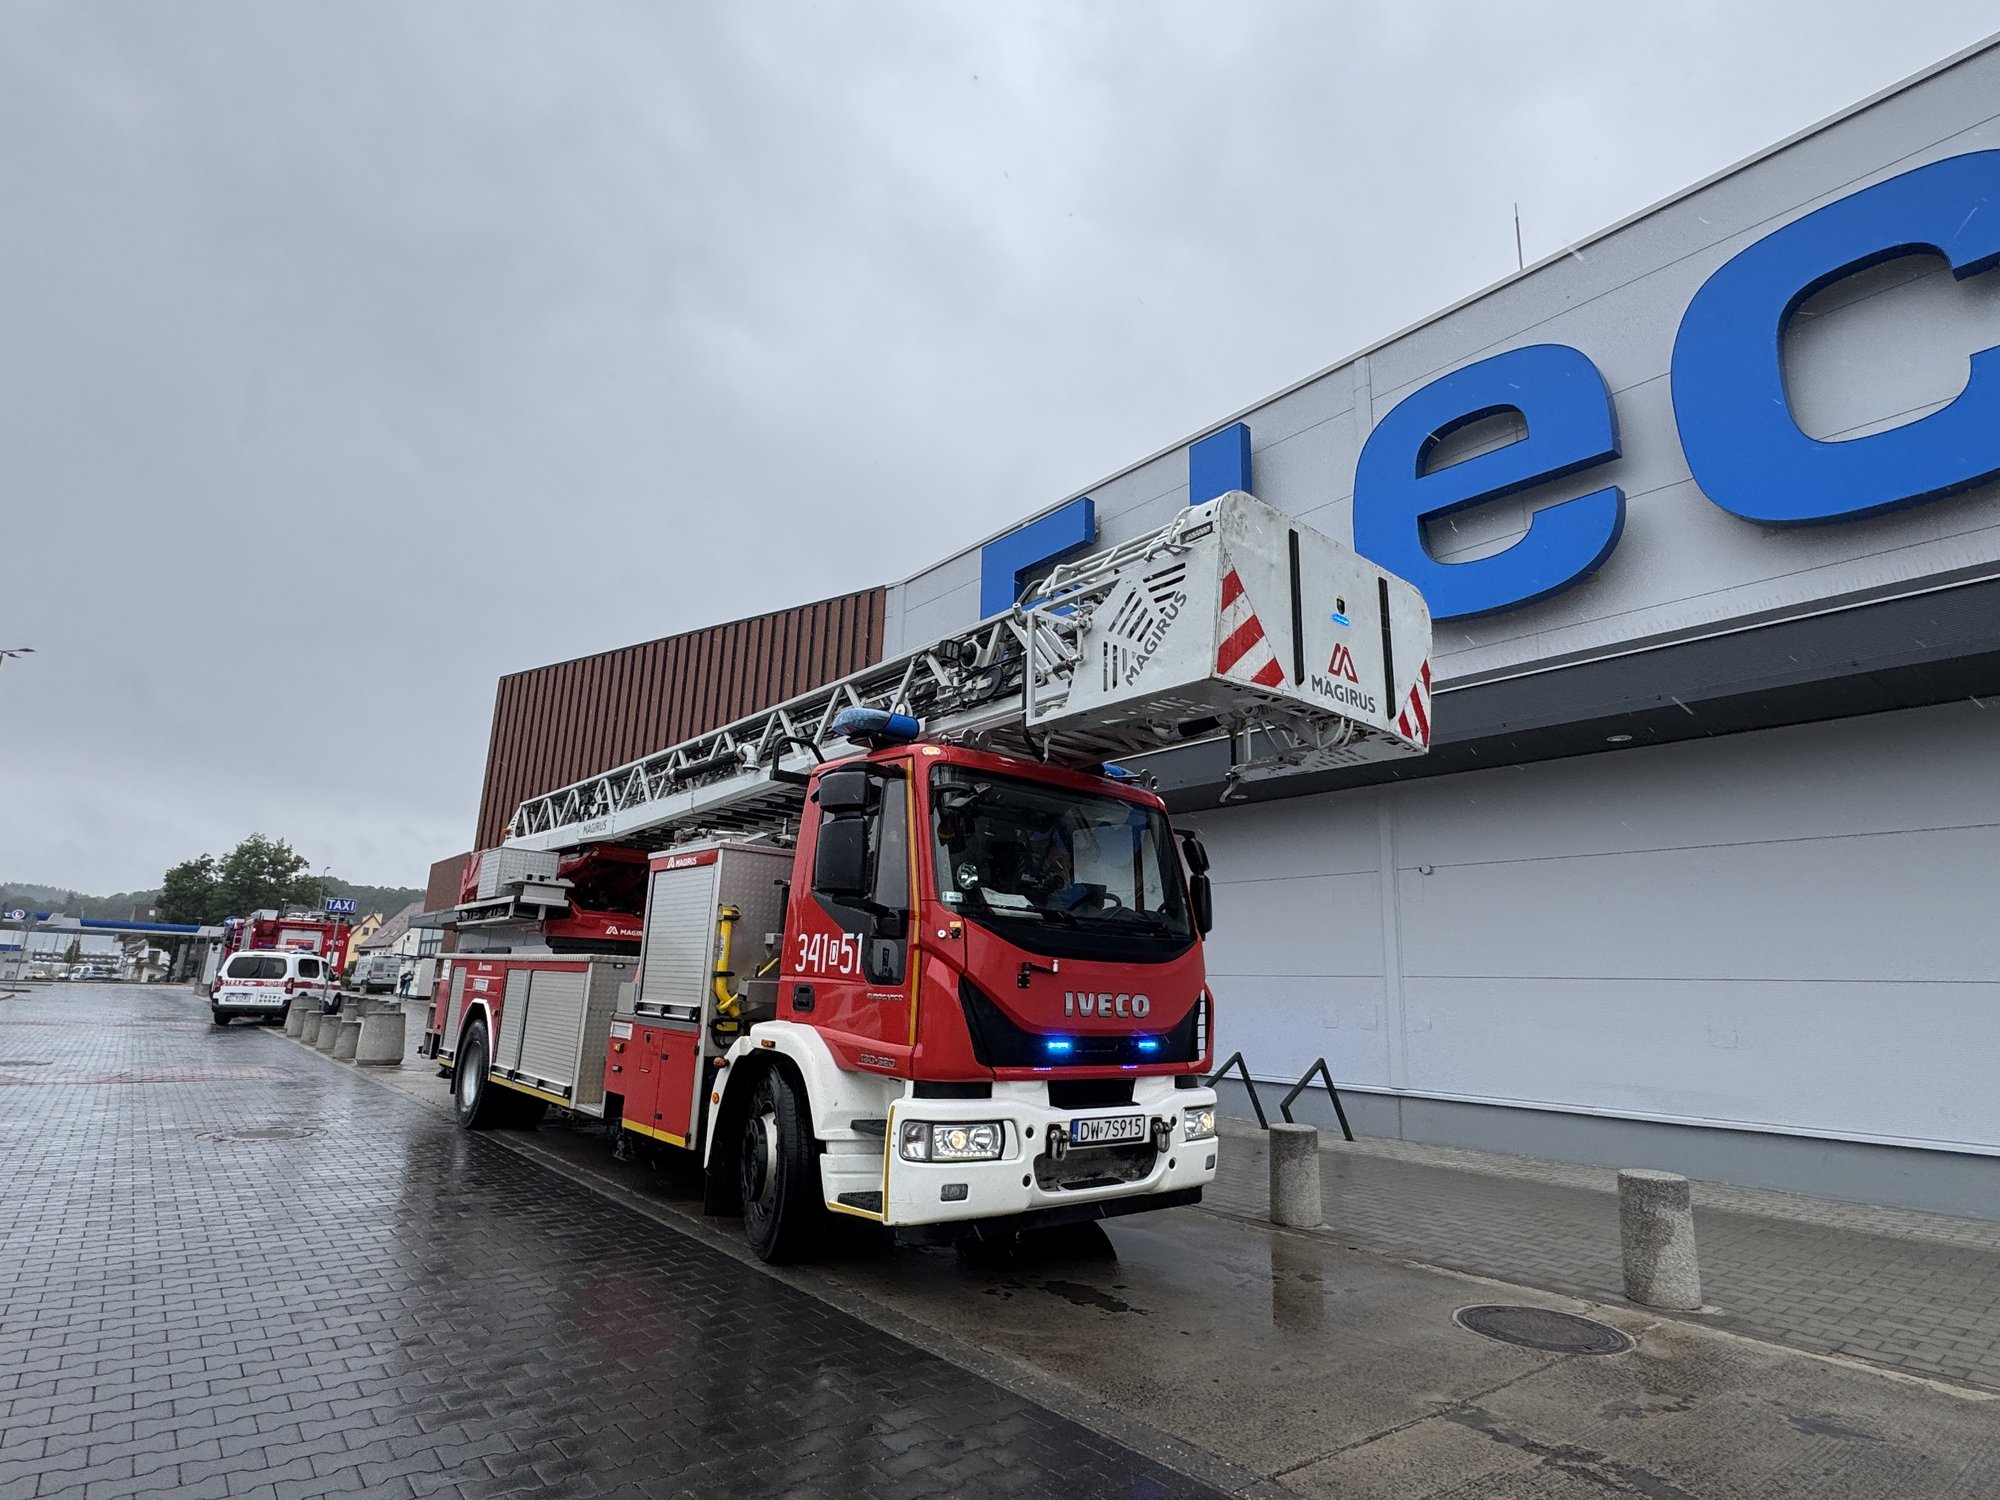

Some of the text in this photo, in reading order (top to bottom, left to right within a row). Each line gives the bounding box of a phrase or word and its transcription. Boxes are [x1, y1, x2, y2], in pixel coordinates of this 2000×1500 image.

[1125, 590, 1187, 686] MAGIRUS
[1311, 674, 1376, 714] MAGIRUS
[583, 819, 607, 834] MAGIRUS
[328, 899, 355, 911] TAXI
[1064, 992, 1150, 1018] IVECO
[1080, 1118, 1141, 1140] DW 7S915
